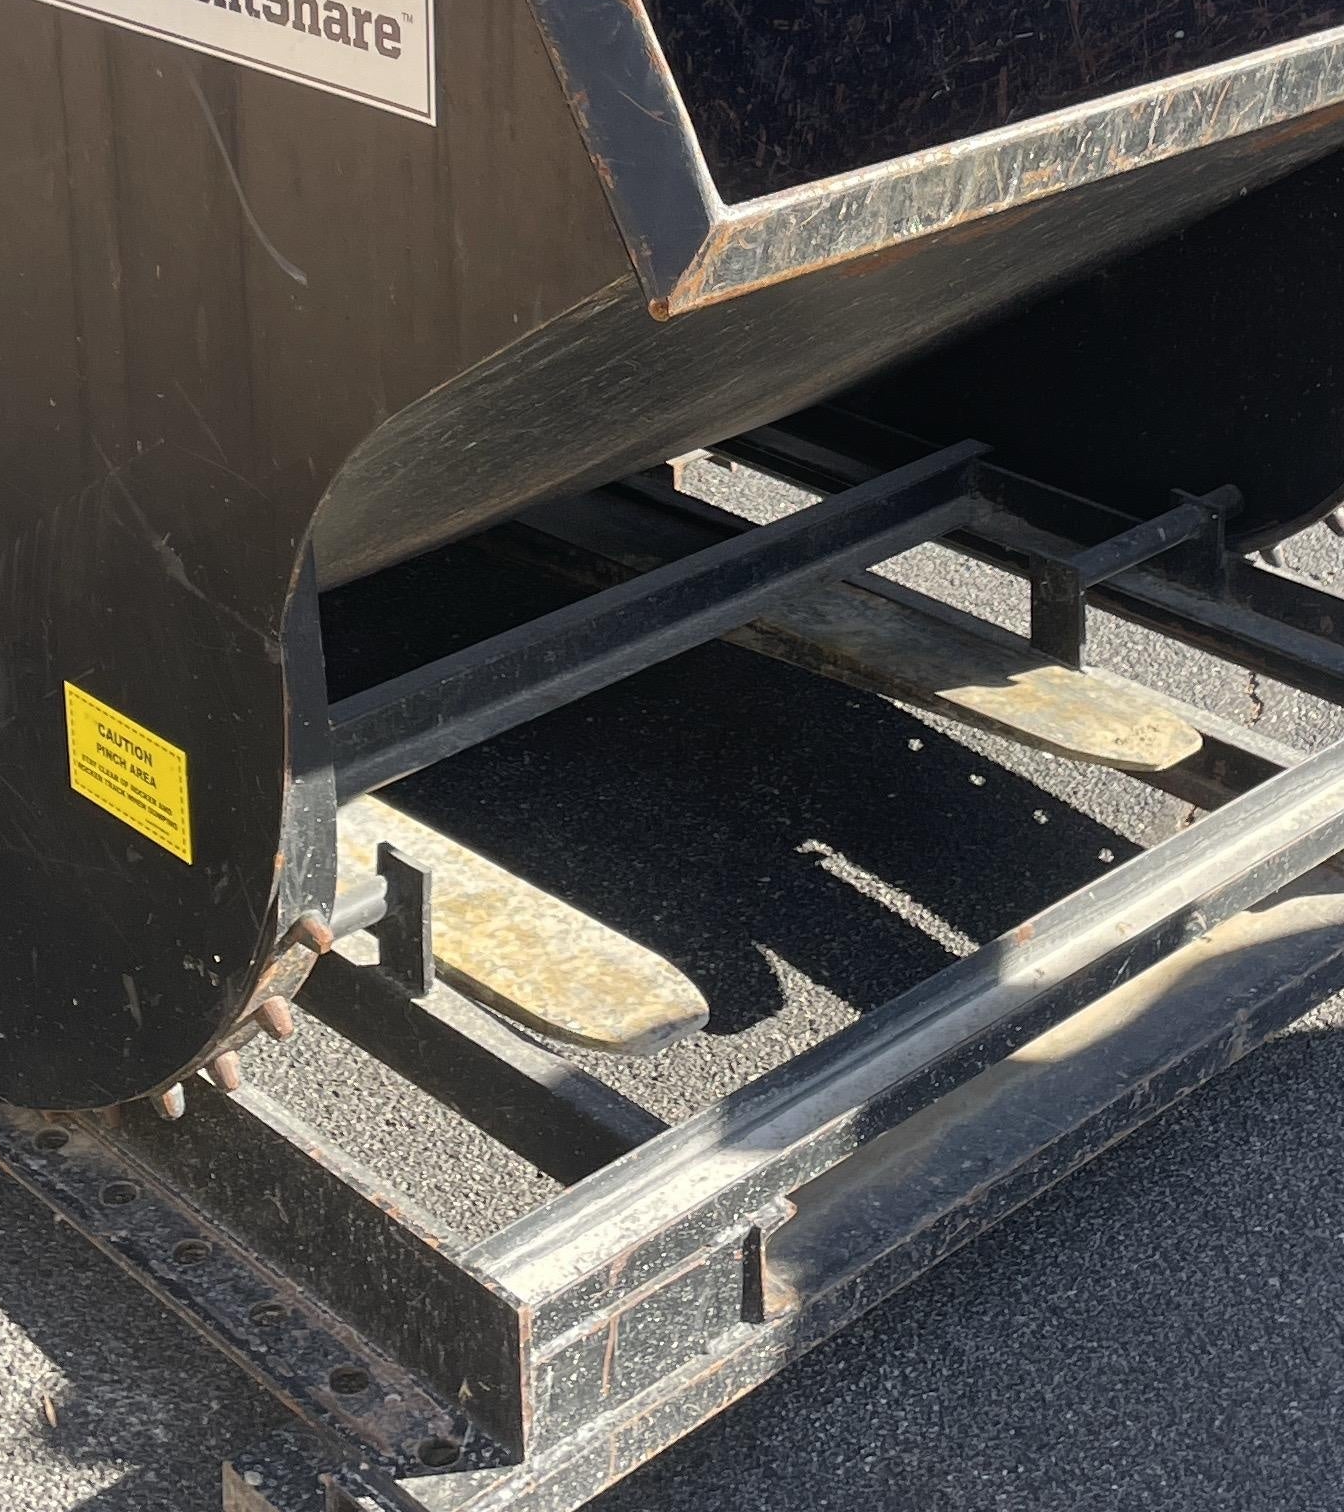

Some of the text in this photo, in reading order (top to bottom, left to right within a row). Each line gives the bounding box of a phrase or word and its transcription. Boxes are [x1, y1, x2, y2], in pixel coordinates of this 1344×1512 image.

[96, 742, 157, 790] PINCH AREA
[97, 722, 154, 769] CAUTION
